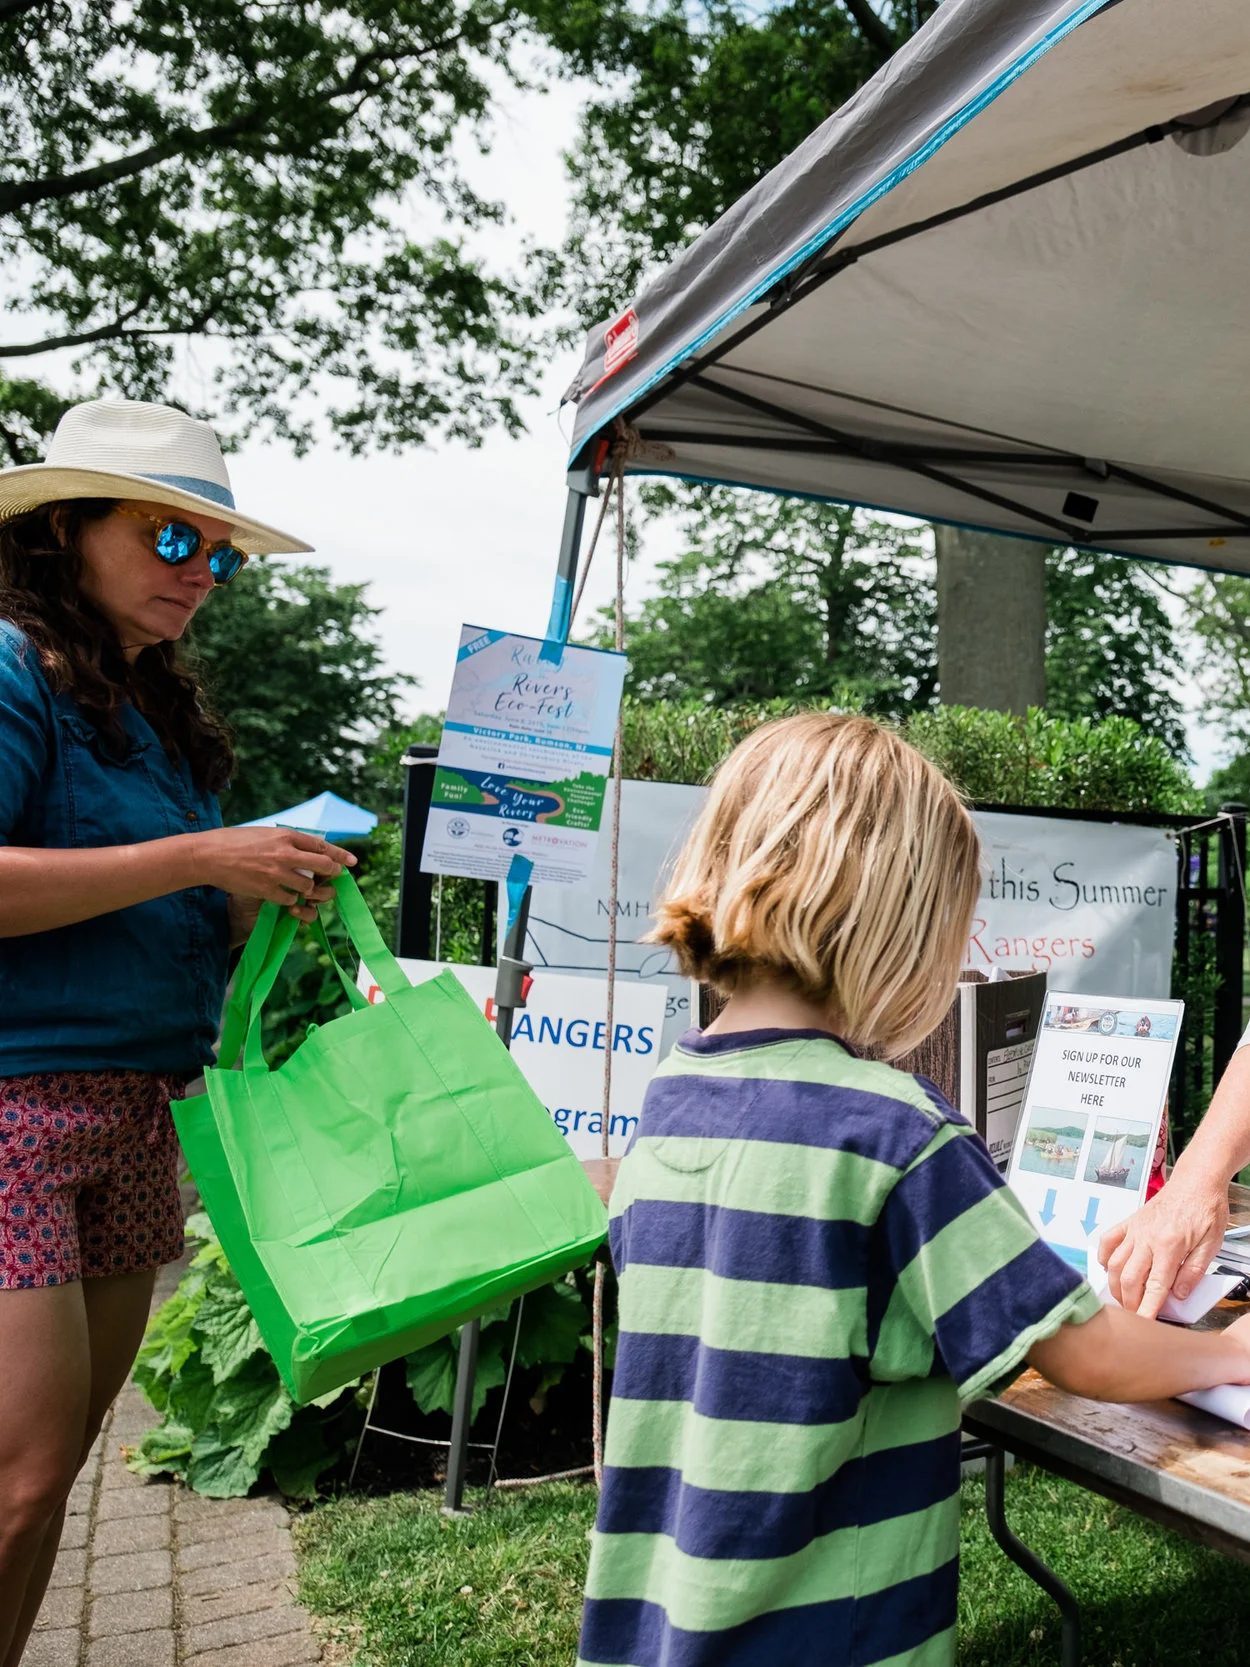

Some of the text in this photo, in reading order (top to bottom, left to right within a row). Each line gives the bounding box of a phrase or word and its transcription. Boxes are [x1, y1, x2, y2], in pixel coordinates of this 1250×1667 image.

[467, 636, 491, 655] FREE
[512, 672, 574, 701] Rivers
[494, 692, 574, 719] Eco-Fest
[473, 727, 507, 740] Victory
[509, 733, 532, 745] Park,
[535, 738, 573, 751] Rumson,
[575, 743, 588, 753] NJ
[440, 782, 468, 794] Family
[444, 791, 463, 800] Fun!
[480, 776, 510, 797] Love
[512, 790, 545, 808] Your
[498, 804, 536, 820] Rivers
[989, 857, 1168, 911] this Summer
[597, 899, 652, 918] NMH
[966, 918, 1096, 972] Rangers
[665, 996, 690, 1018] ge
[485, 998, 654, 1056] ANGERS
[1062, 1049, 1142, 1069] SIGN UP FOR OUR
[1067, 1070, 1127, 1088] NEWSLETTER
[1080, 1093, 1104, 1107] HERE
[548, 1105, 639, 1137] gram
